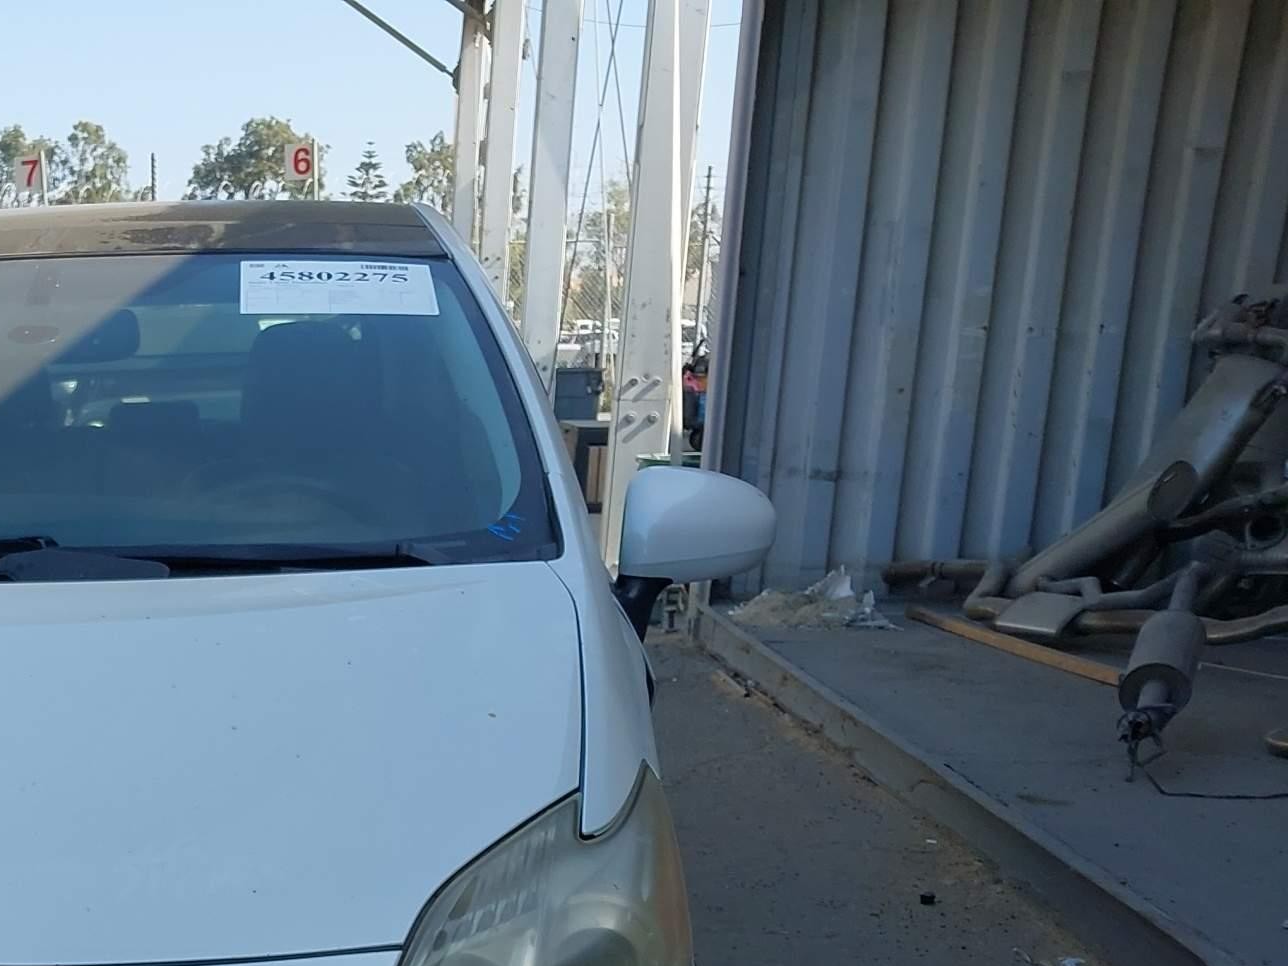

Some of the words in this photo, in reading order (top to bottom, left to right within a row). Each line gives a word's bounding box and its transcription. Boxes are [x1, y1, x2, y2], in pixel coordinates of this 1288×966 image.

[20, 159, 39, 188] 7
[293, 147, 311, 176] 6
[260, 271, 409, 284] 45802275
